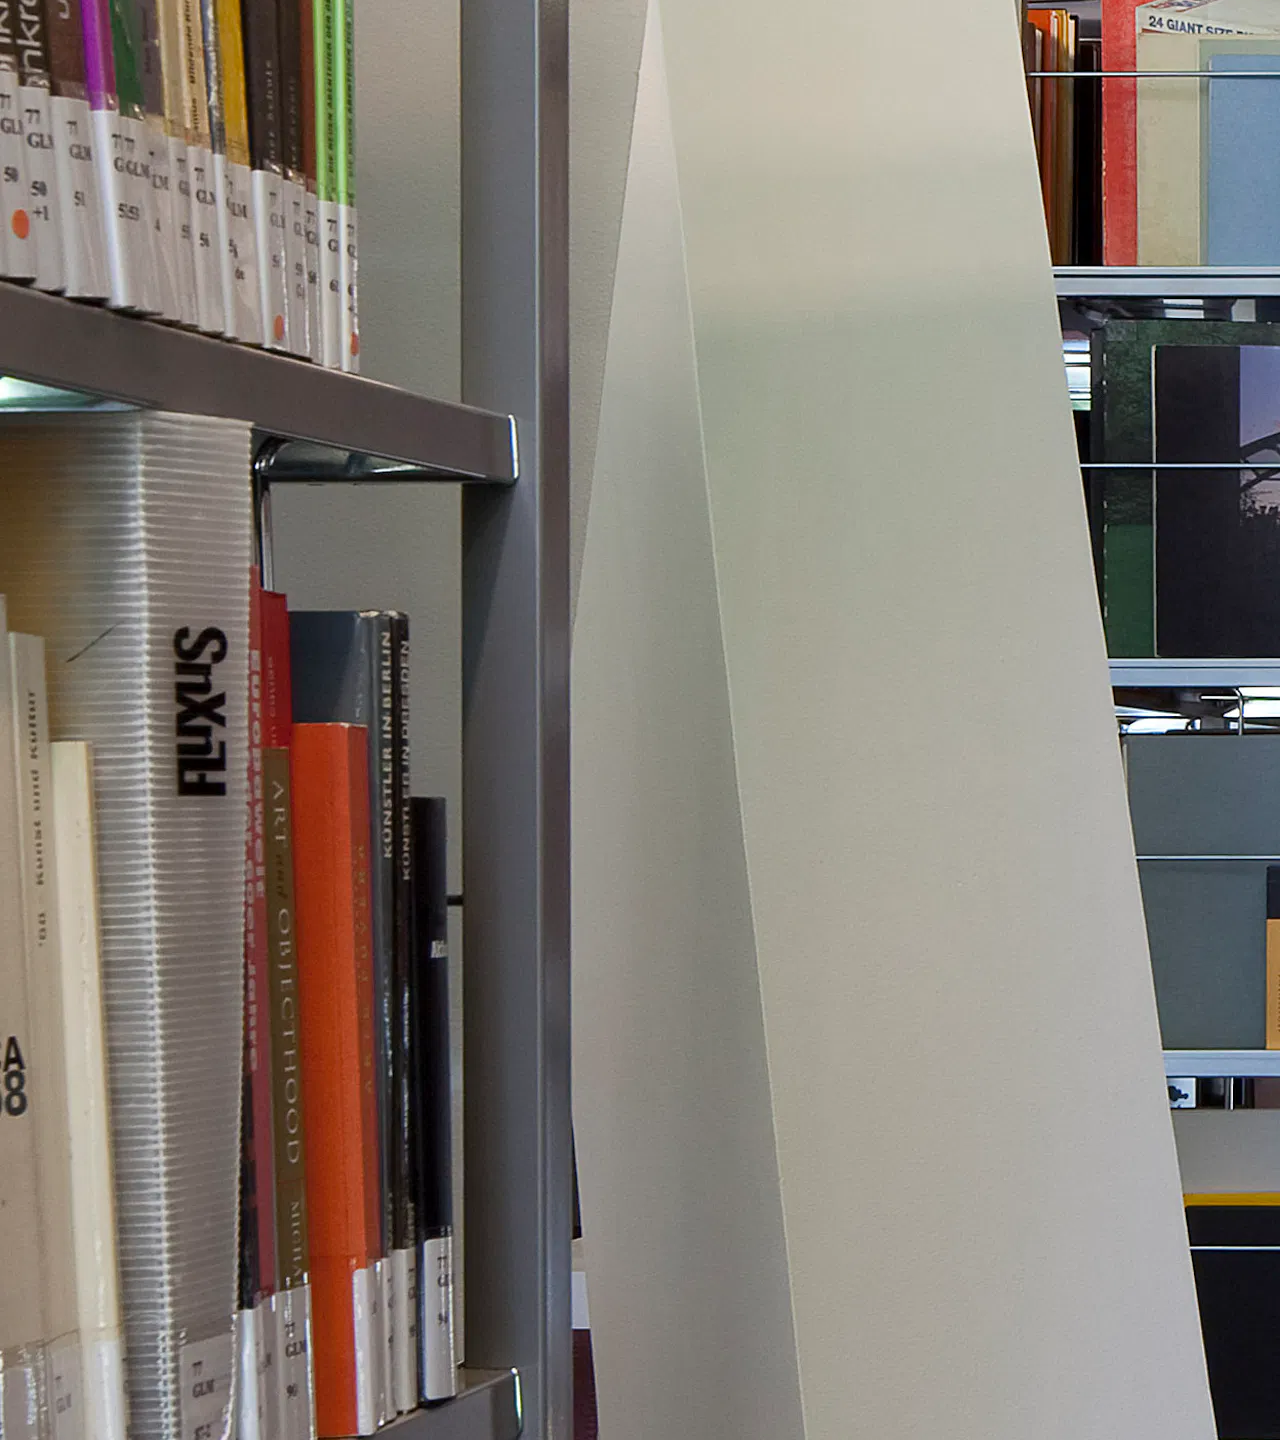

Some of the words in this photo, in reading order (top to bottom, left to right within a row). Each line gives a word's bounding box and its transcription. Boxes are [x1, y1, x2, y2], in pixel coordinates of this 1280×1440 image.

[1149, 16, 1163, 28] 24
[1166, 19, 1203, 35] GIANT
[24, 109, 41, 124] 77
[381, 631, 391, 709] BERLIN
[382, 715, 392, 739] IN
[401, 745, 410, 765] IN
[272, 780, 289, 849] ART
[381, 747, 392, 858] KÜNSTLER
[277, 907, 302, 1165] OBJECTHOOD
[288, 1201, 303, 1276] MICHA
